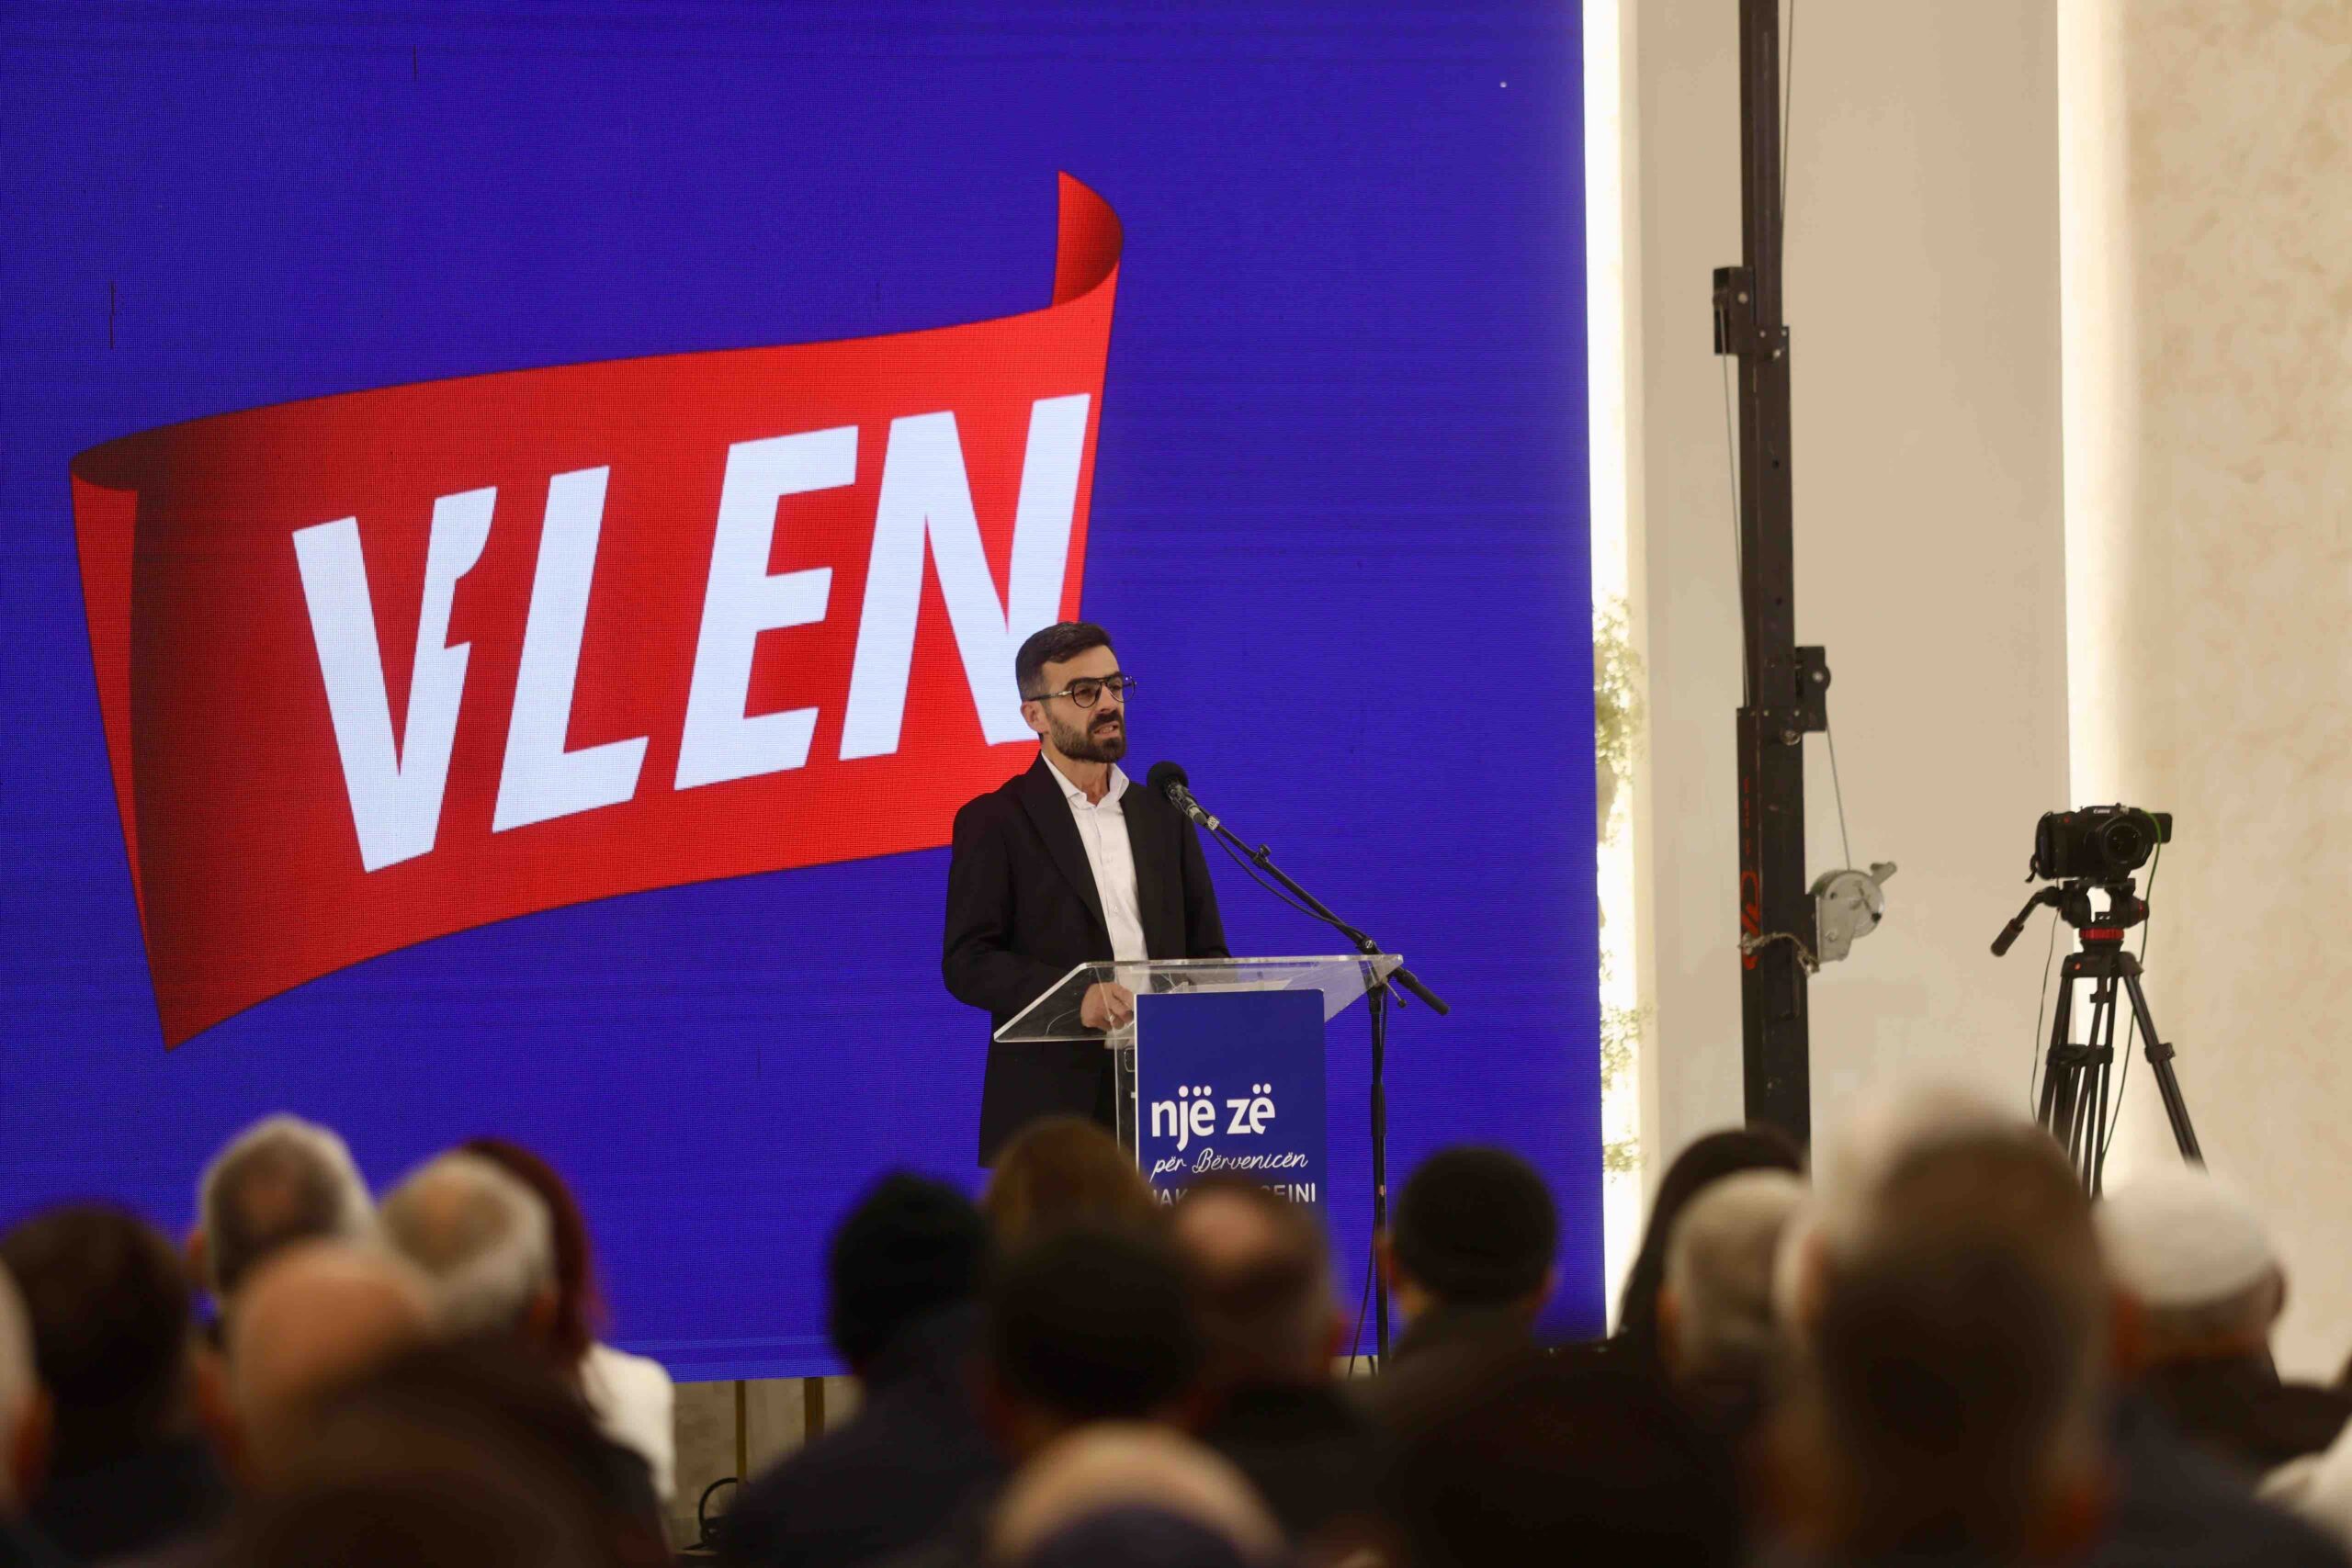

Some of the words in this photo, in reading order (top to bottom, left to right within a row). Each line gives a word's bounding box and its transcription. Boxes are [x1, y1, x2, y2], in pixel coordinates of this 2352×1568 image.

[291, 393, 1091, 873] VLEN
[1151, 1085, 1216, 1152] një
[1226, 1083, 1276, 1135] zë
[1148, 1156, 1187, 1184] për
[1192, 1147, 1309, 1174] Bërvenicën
